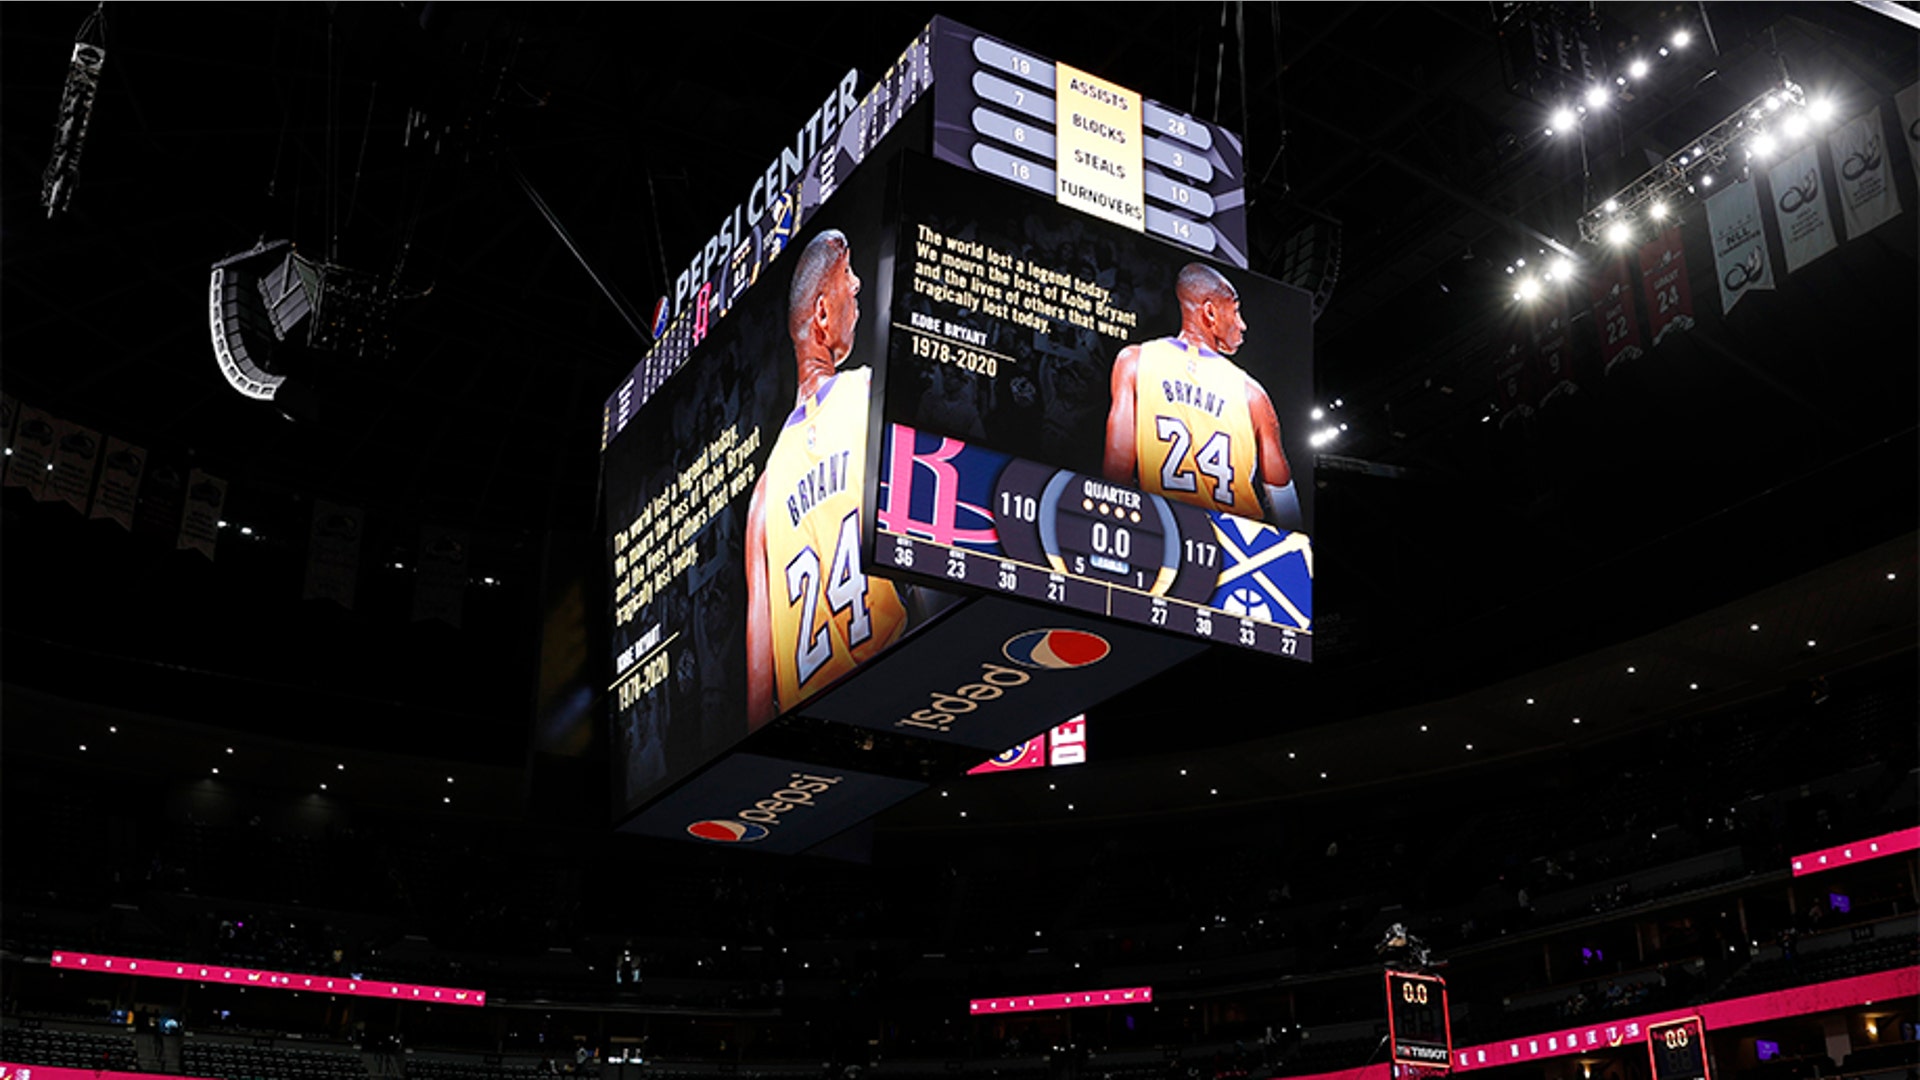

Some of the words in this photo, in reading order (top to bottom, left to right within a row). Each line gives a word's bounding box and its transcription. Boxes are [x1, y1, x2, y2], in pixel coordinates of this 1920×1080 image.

[1014, 91, 1025, 106] 7
[1069, 78, 1129, 111] ASSISTS
[1071, 113, 1127, 145] BLOCKS
[1074, 148, 1127, 180] STEALS
[1173, 152, 1184, 167] 3
[675, 204, 742, 317] PEPSI
[748, 67, 859, 227] CENTER
[1060, 178, 1144, 221] TURNOVERS
[1171, 186, 1190, 204] 10
[1172, 221, 1191, 239] 14
[918, 224, 942, 246] The
[946, 237, 984, 260] world
[987, 247, 1013, 270] lost
[1016, 260, 1025, 273] a
[1028, 261, 1072, 288] legend
[1074, 277, 1113, 303] today.
[915, 260, 941, 279] and
[945, 269, 967, 288] the
[972, 276, 1002, 299] lives
[1006, 290, 1020, 305] of
[1024, 294, 1066, 321] others
[1069, 308, 1095, 330] that
[1098, 320, 1129, 341] were
[916, 242, 938, 262] We
[941, 253, 985, 277] mourn
[989, 266, 1011, 286] the
[1014, 275, 1040, 295] loss
[1044, 285, 1057, 299] of
[1062, 288, 1092, 312] Kobe
[1096, 301, 1137, 327] Bryant
[1657, 284, 1679, 313] 24
[913, 276, 980, 313] tragically
[982, 298, 1009, 320] lost
[1012, 307, 1052, 334] today.
[911, 312, 941, 332] KOBE
[945, 319, 988, 347] BRYANT
[1606, 315, 1628, 345] 22
[911, 335, 998, 379] 1978-2020
[1162, 379, 1226, 419] BRYANT
[1155, 414, 1235, 507] 24
[786, 450, 850, 528] BRYANT
[1083, 480, 1142, 510] QUARTER
[1001, 491, 1037, 523] 110
[1091, 522, 1131, 558] 0.0
[1185, 538, 1218, 569] 117
[893, 547, 914, 567] 36
[946, 559, 966, 580] 23
[1075, 556, 1085, 575] 5
[998, 571, 1017, 591] 30
[1047, 584, 1066, 603] 21
[1136, 571, 1144, 588] 1
[785, 507, 872, 691] 24
[1151, 606, 1168, 625] 27
[1239, 628, 1256, 646] 33
[1281, 638, 1297, 655] 27
[897, 663, 1031, 732] pepsi
[738, 772, 843, 825] pepsi
[1403, 981, 1428, 1005] 0.0
